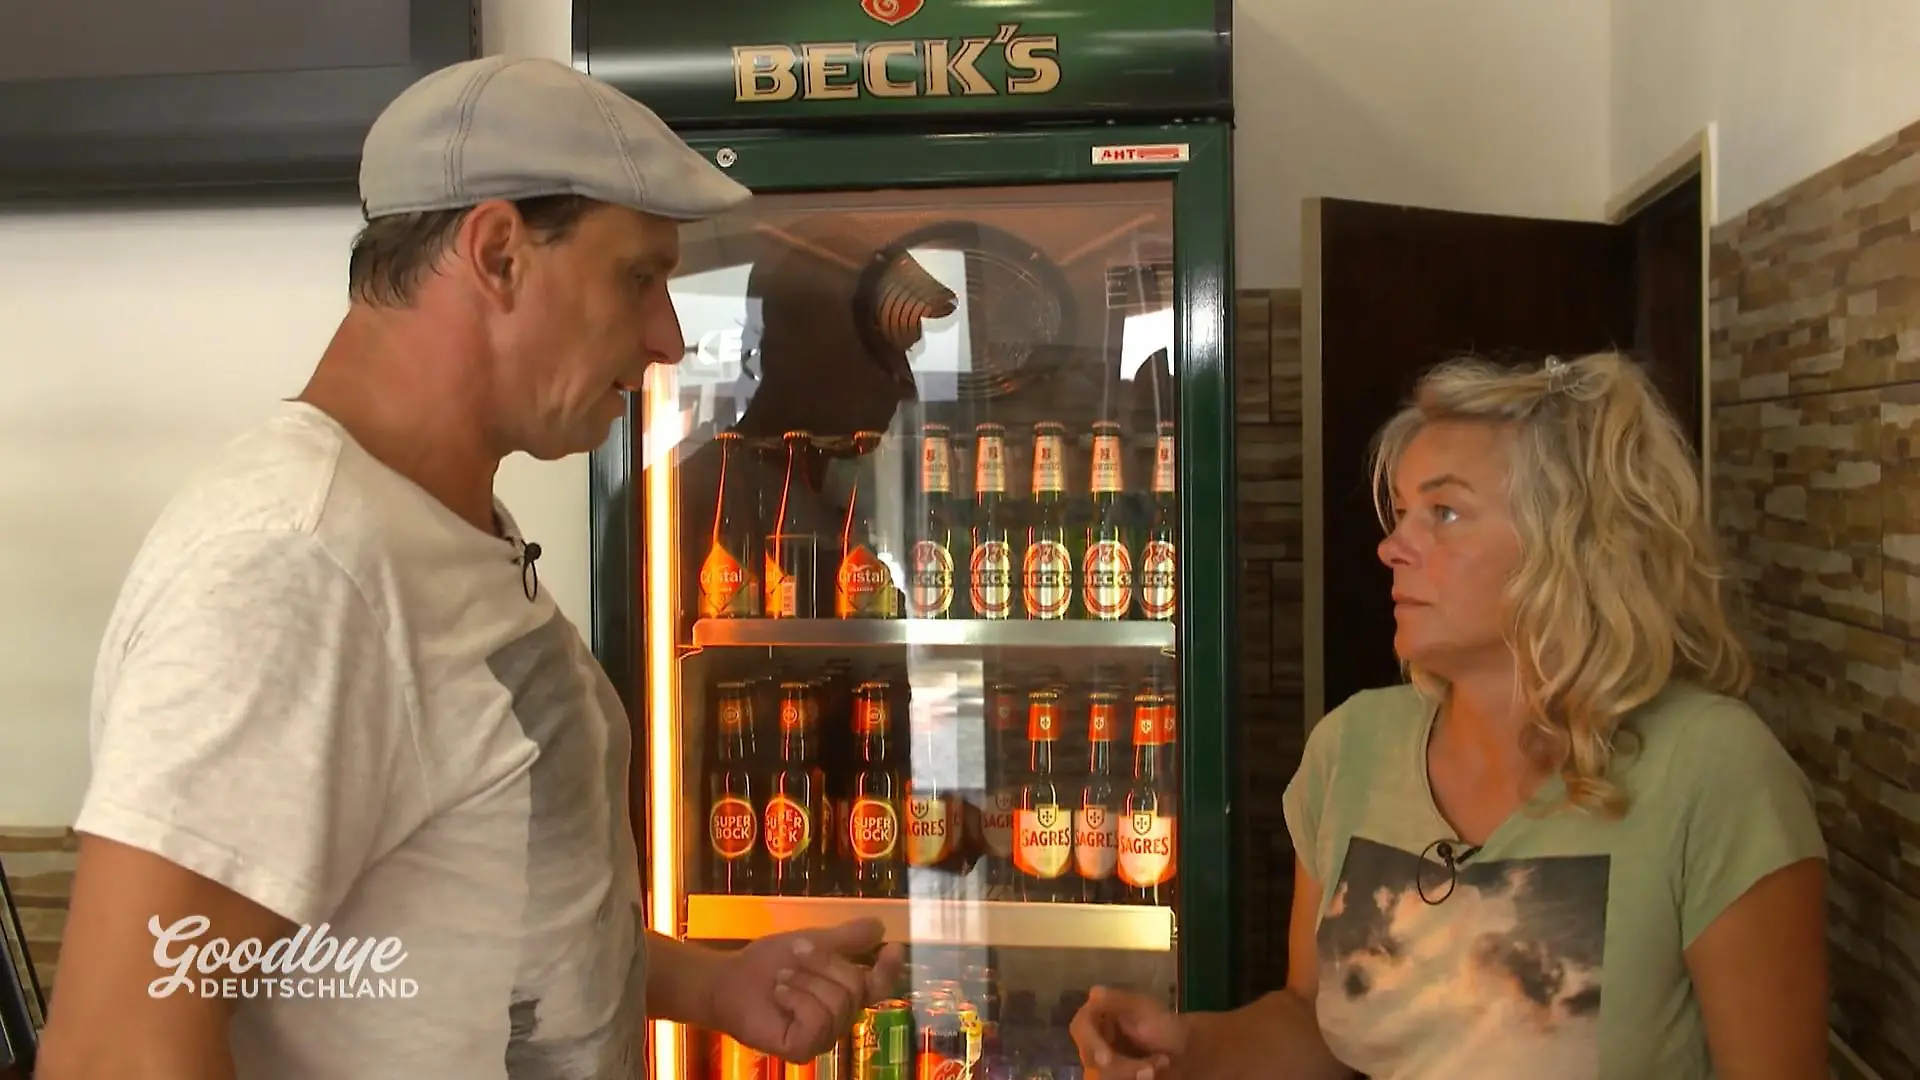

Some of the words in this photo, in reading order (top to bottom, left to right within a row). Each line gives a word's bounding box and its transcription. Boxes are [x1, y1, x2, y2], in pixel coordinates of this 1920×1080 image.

[732, 24, 1061, 101] BECK'S
[713, 815, 751, 828] SUPER
[716, 826, 749, 840] BOCK
[1023, 828, 1070, 847] SAGRES
[1120, 837, 1169, 856] SAGRES
